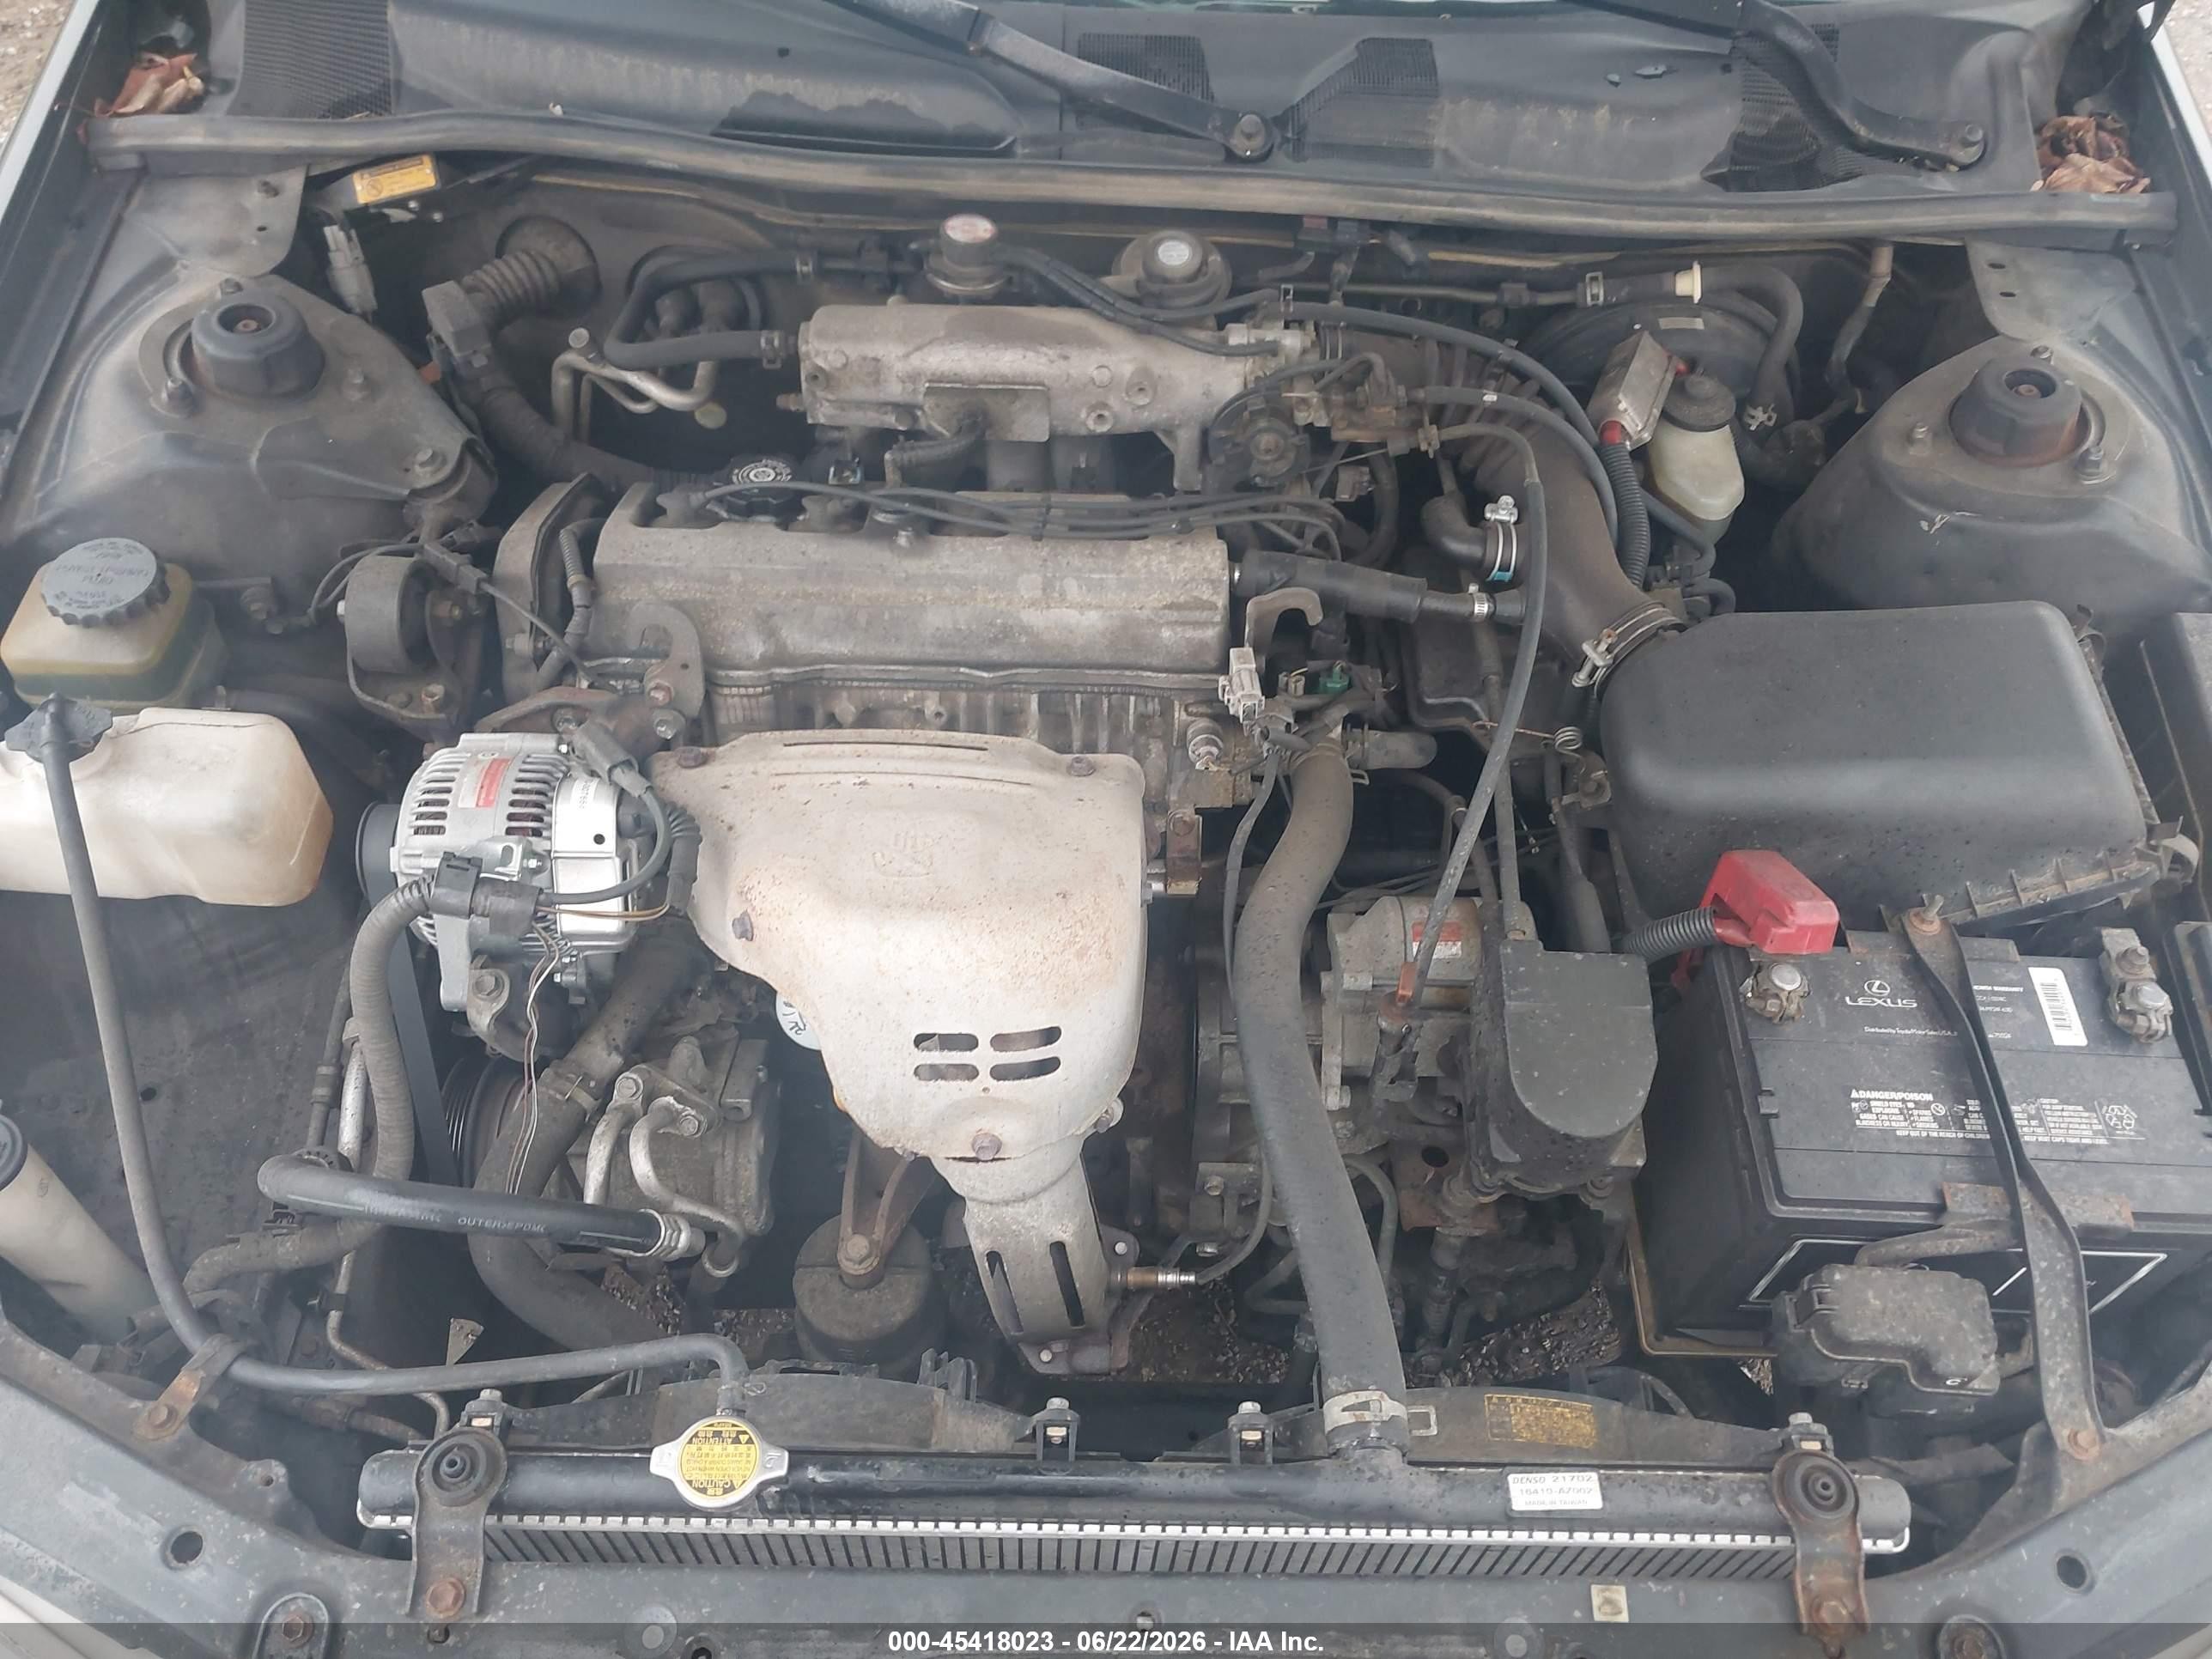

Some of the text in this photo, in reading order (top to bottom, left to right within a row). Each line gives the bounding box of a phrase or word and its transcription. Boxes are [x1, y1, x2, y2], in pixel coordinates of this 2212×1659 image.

[1845, 996, 1917, 1008] LEXUS
[691, 1480, 731, 1488] CAUTION
[1512, 1476, 1546, 1485] DENSO
